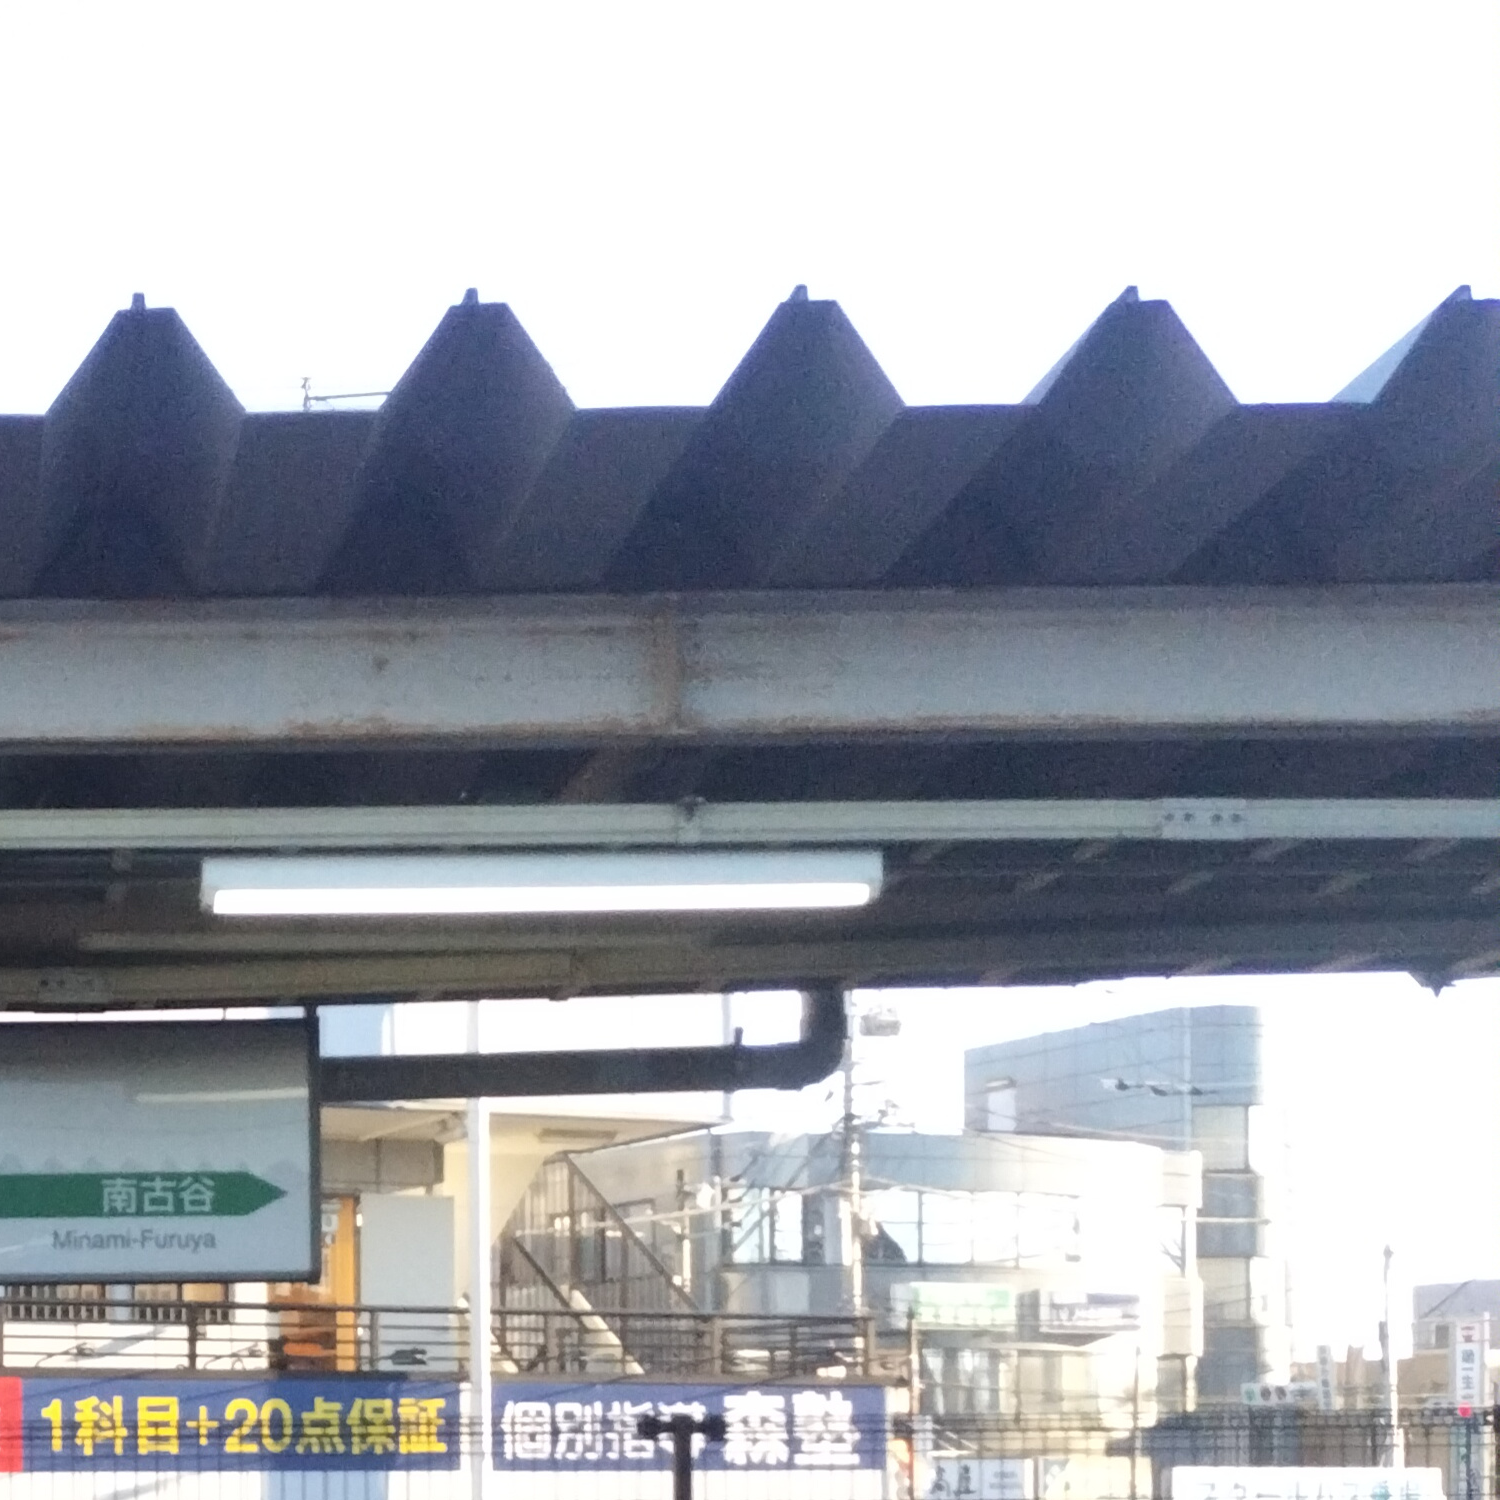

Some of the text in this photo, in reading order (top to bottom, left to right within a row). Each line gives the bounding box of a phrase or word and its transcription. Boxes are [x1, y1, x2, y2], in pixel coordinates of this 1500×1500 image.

[101, 1176, 216, 1214] 南古谷
[51, 1228, 216, 1252] Minami-Furuya
